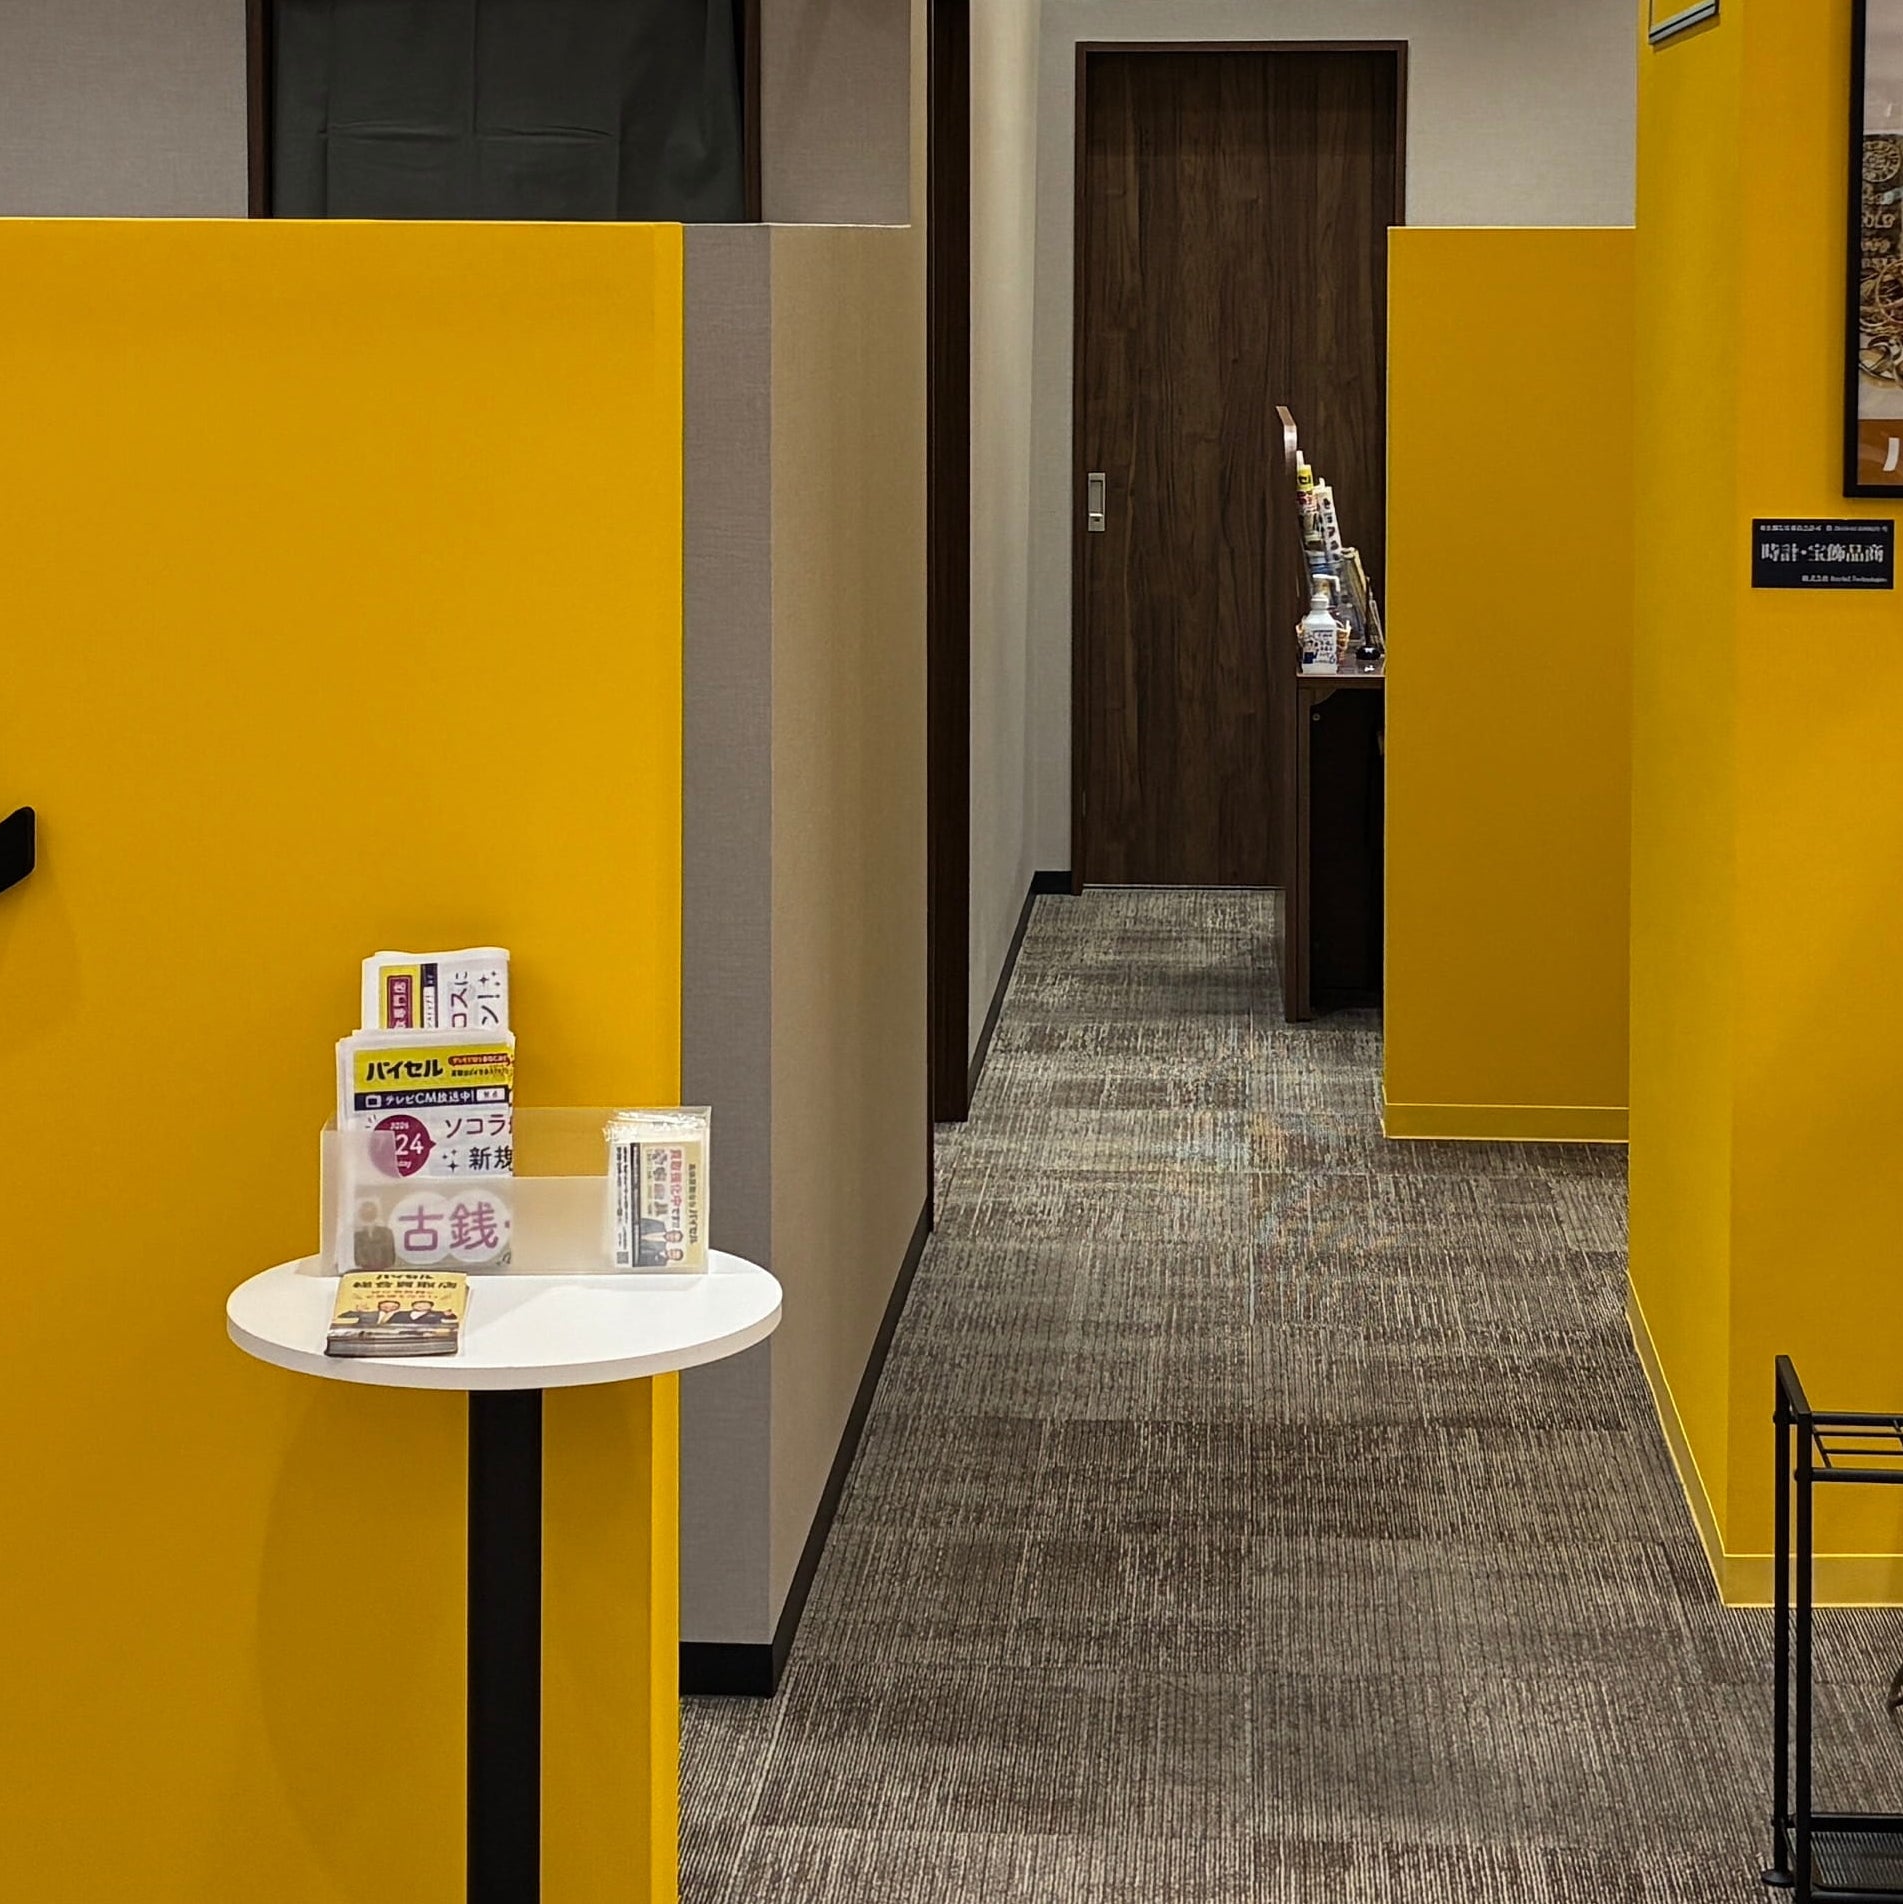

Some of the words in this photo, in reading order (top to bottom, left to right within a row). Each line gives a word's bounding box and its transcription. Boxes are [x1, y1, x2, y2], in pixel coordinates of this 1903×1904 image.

[366, 1059, 443, 1081] バイセル
[445, 1114, 512, 1139] ソコラ
